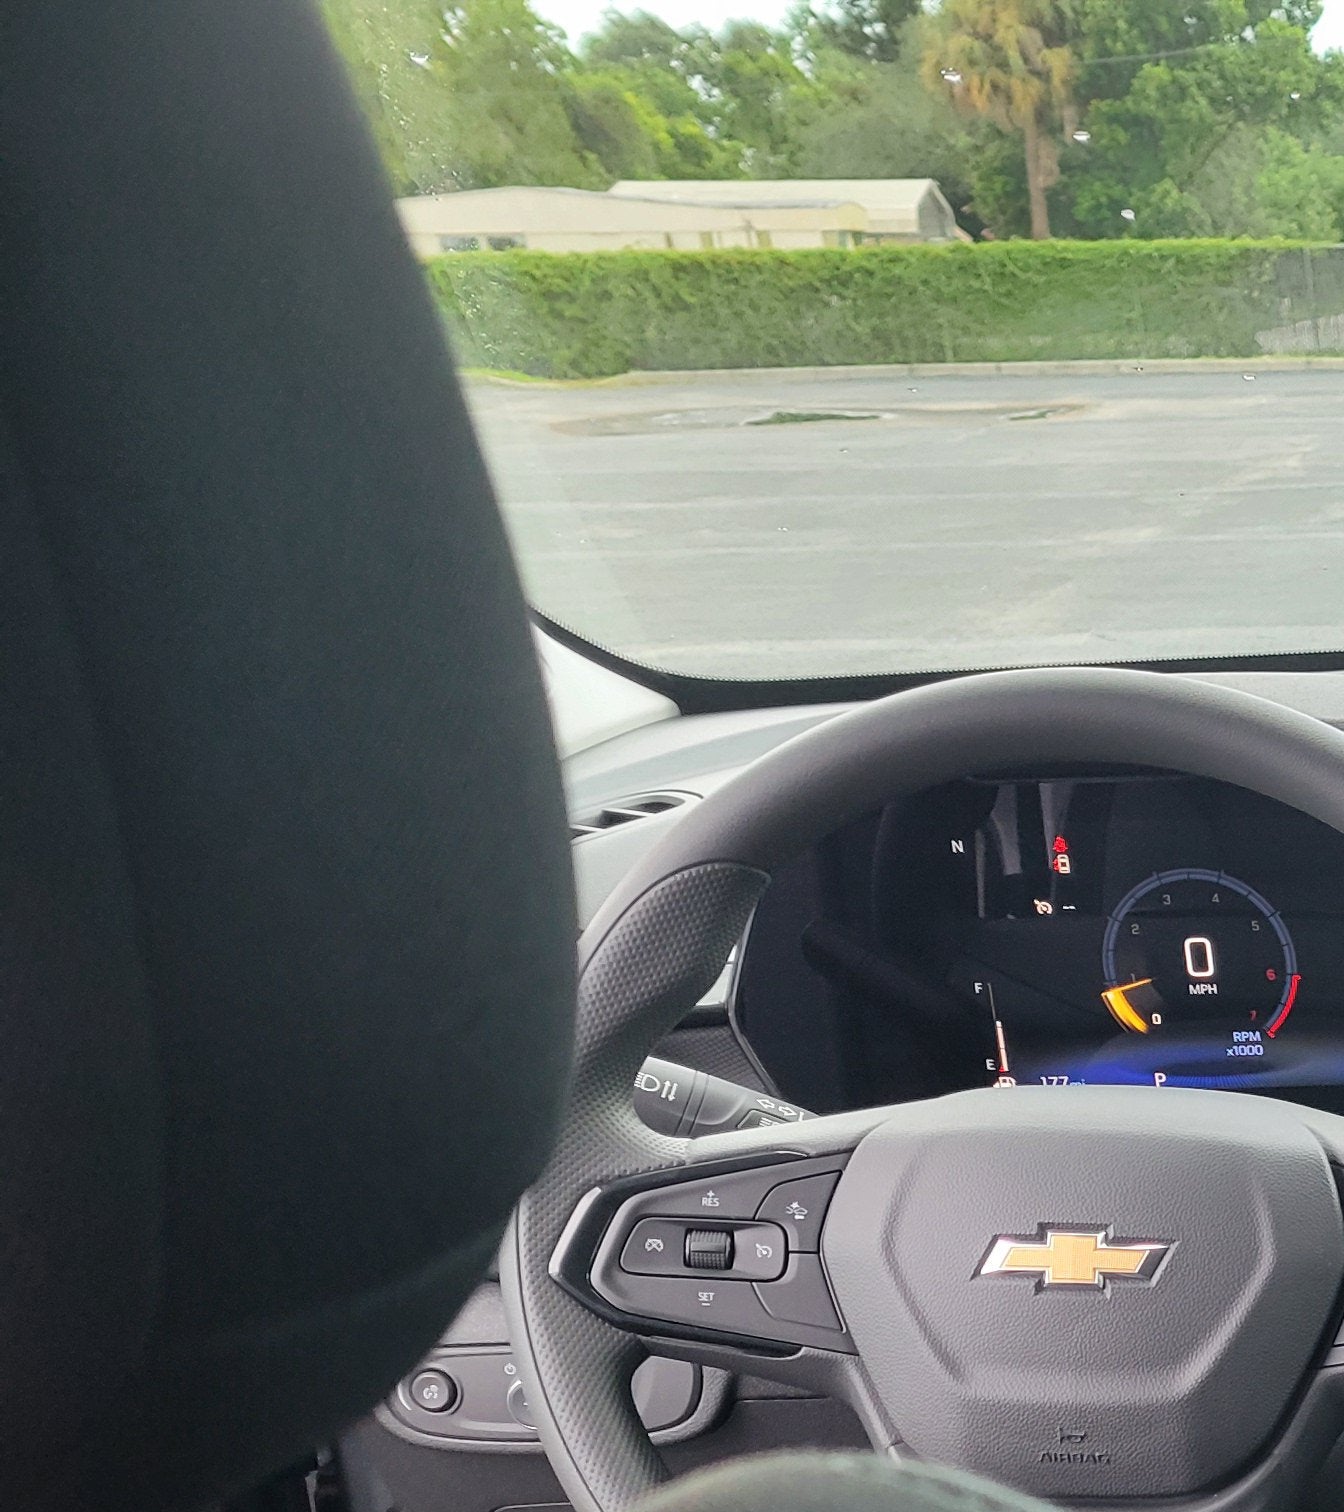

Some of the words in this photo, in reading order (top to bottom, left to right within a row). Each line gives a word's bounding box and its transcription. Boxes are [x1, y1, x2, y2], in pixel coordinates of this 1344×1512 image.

[951, 839, 965, 853] N
[1162, 894, 1171, 905] 3
[1212, 893, 1220, 903] 4
[1131, 923, 1140, 935] 2
[1251, 920, 1260, 931] 5
[1184, 937, 1215, 978] 0
[1266, 969, 1276, 980] 6
[974, 982, 983, 994] F
[1189, 983, 1218, 995] MPH
[1151, 1013, 1162, 1025] 0
[1250, 1010, 1257, 1020] 7
[1232, 1031, 1262, 1042] RPM
[1226, 1045, 1264, 1056] x1000
[986, 1059, 996, 1071] E
[1154, 1072, 1167, 1087] P
[701, 1197, 720, 1207] RES
[698, 1292, 715, 1301] SET
